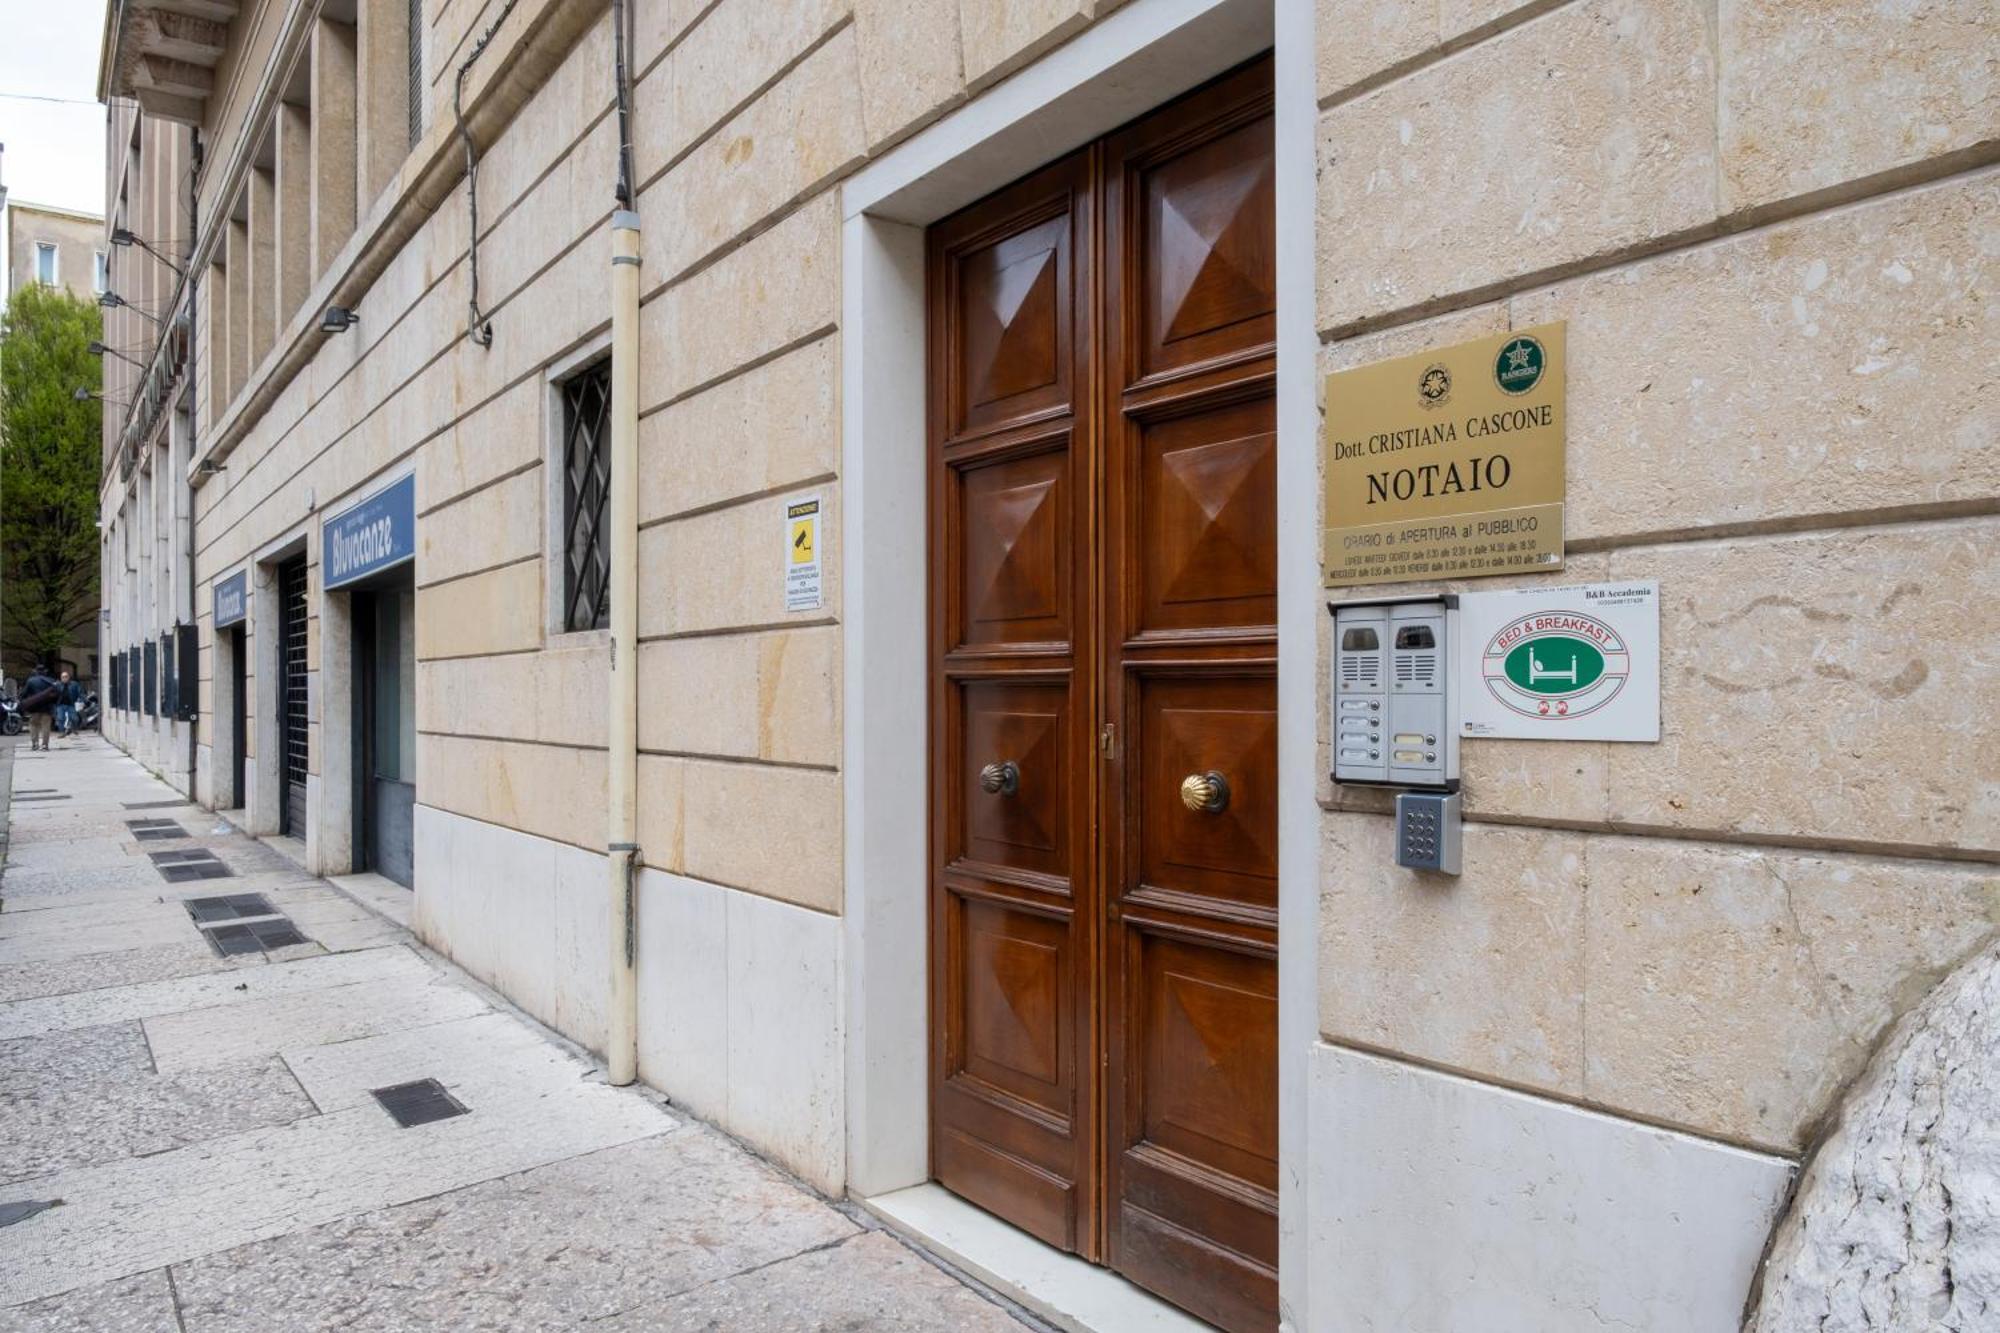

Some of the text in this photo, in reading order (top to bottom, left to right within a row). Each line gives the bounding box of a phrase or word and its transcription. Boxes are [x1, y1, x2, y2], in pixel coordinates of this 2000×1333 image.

[1334, 404, 1552, 460] Dott. CRISTIANA CASCONE
[1366, 454, 1511, 505] NOTAIO
[332, 514, 393, 577] Bluvacanze
[1343, 516, 1538, 549] ORARIO di APERTURA al PUBBLICO
[1607, 587, 1651, 599] Accademia
[1498, 616, 1612, 648] BED & BREAKFAST
